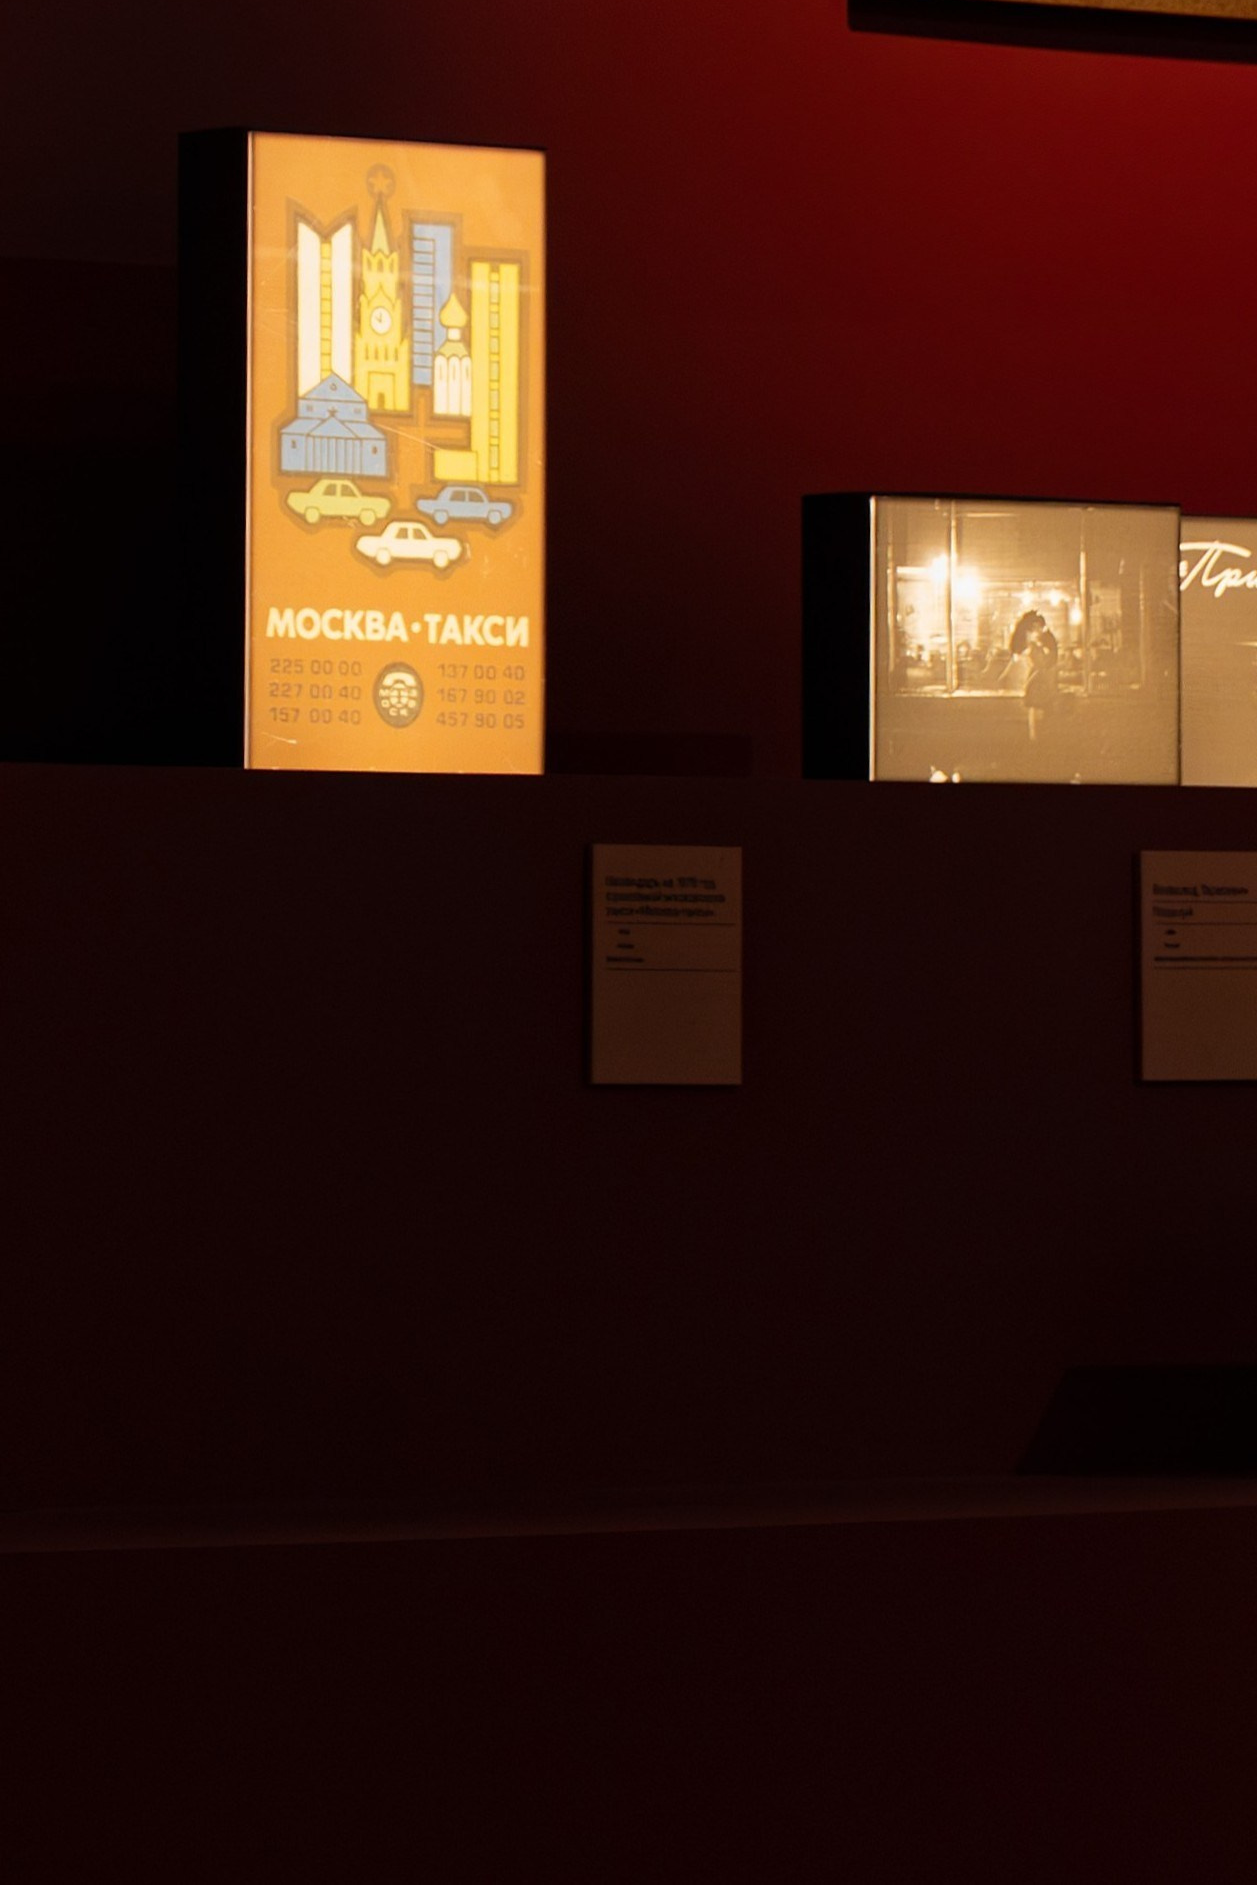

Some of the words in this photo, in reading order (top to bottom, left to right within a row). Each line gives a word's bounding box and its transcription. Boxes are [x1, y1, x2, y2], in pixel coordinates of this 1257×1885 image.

[269, 658, 304, 674] 225
[310, 659, 333, 675] 00
[338, 660, 362, 676] 00
[473, 664, 496, 681] 00
[502, 665, 525, 681] 40
[268, 681, 302, 699] 227
[309, 683, 333, 700] 00
[338, 685, 362, 701] 40
[309, 708, 332, 725] 00
[338, 709, 361, 725] 40
